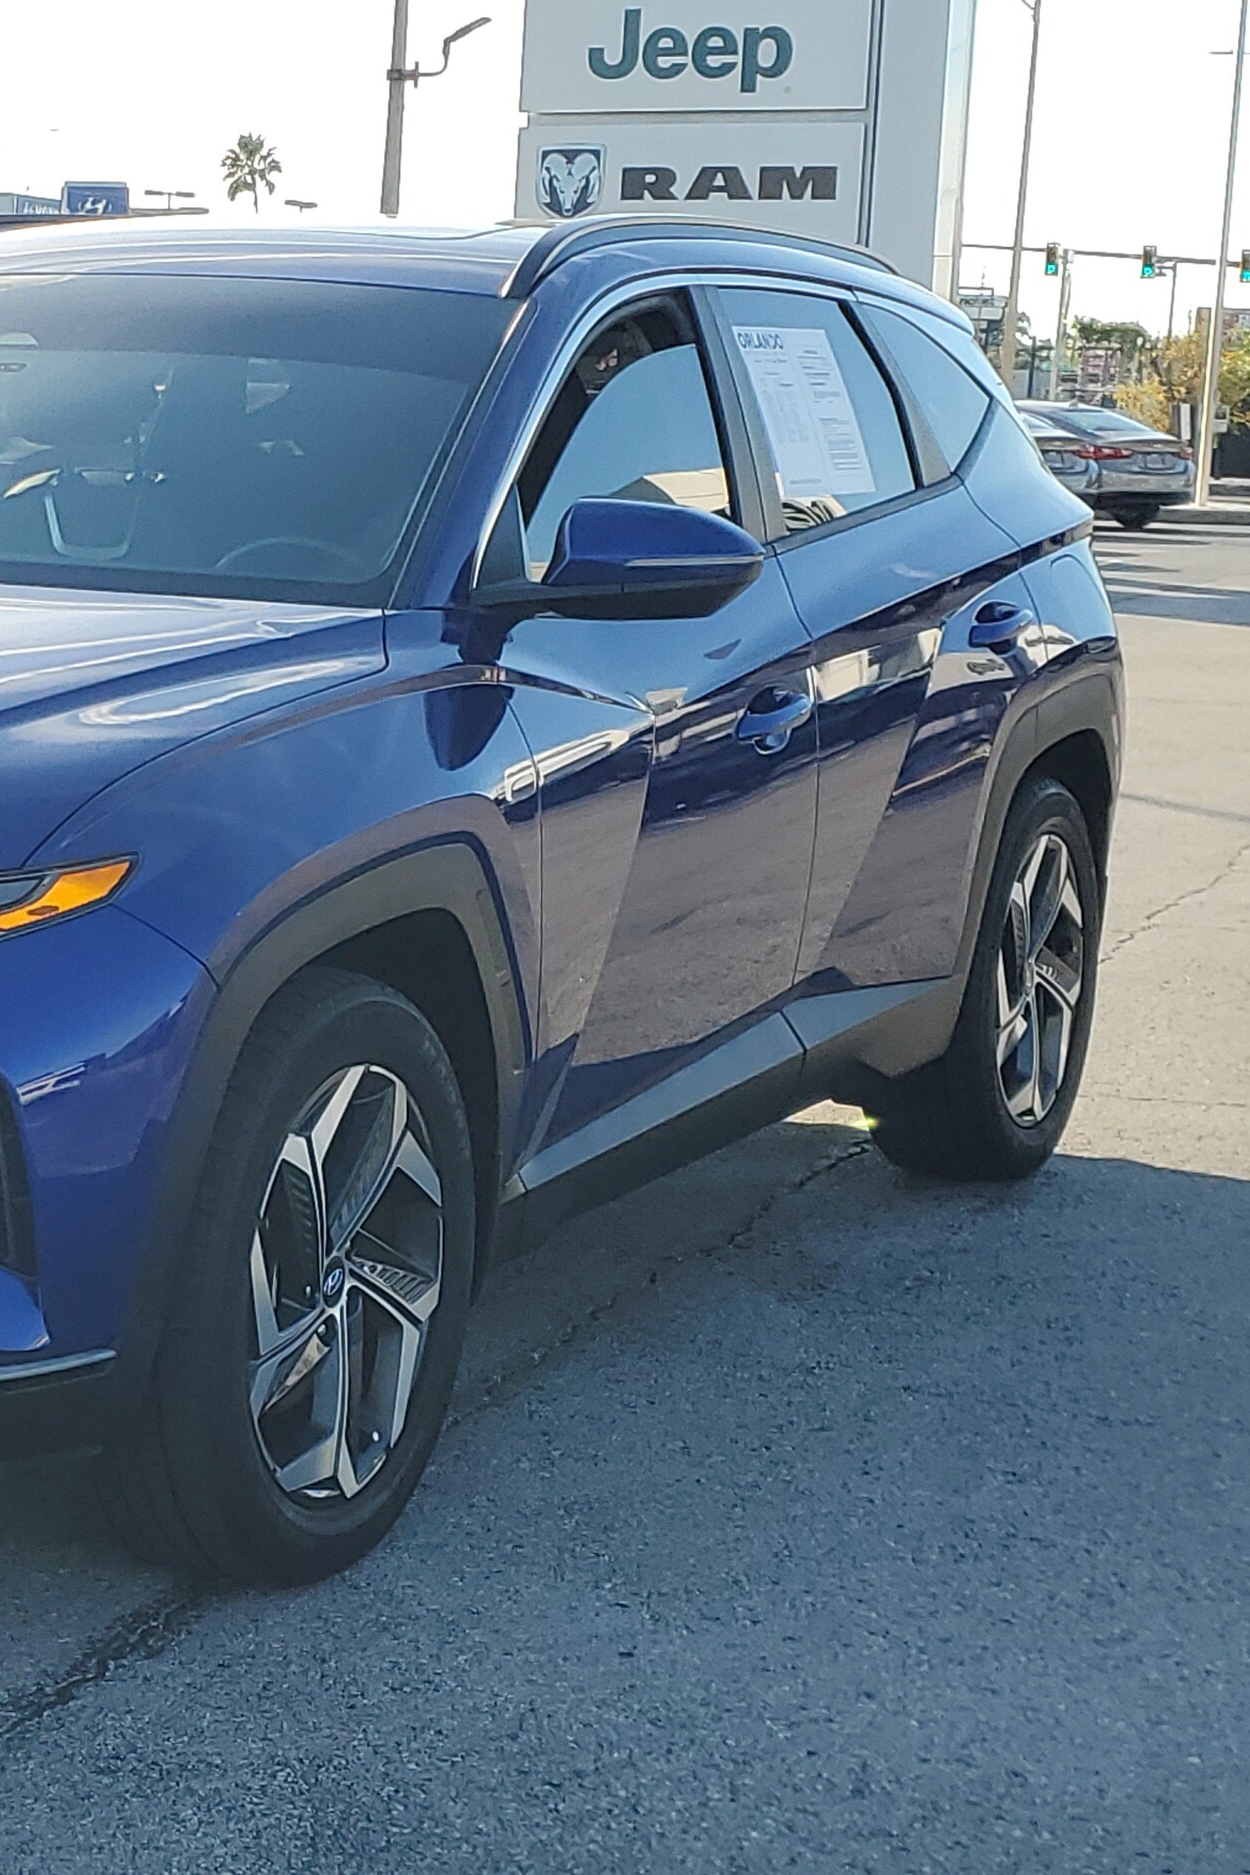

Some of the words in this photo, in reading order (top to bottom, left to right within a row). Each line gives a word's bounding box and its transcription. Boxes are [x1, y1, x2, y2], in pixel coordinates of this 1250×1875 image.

[588, 8, 793, 93] Jeep
[620, 166, 838, 200] RAM
[737, 332, 784, 349] ORLANDO
